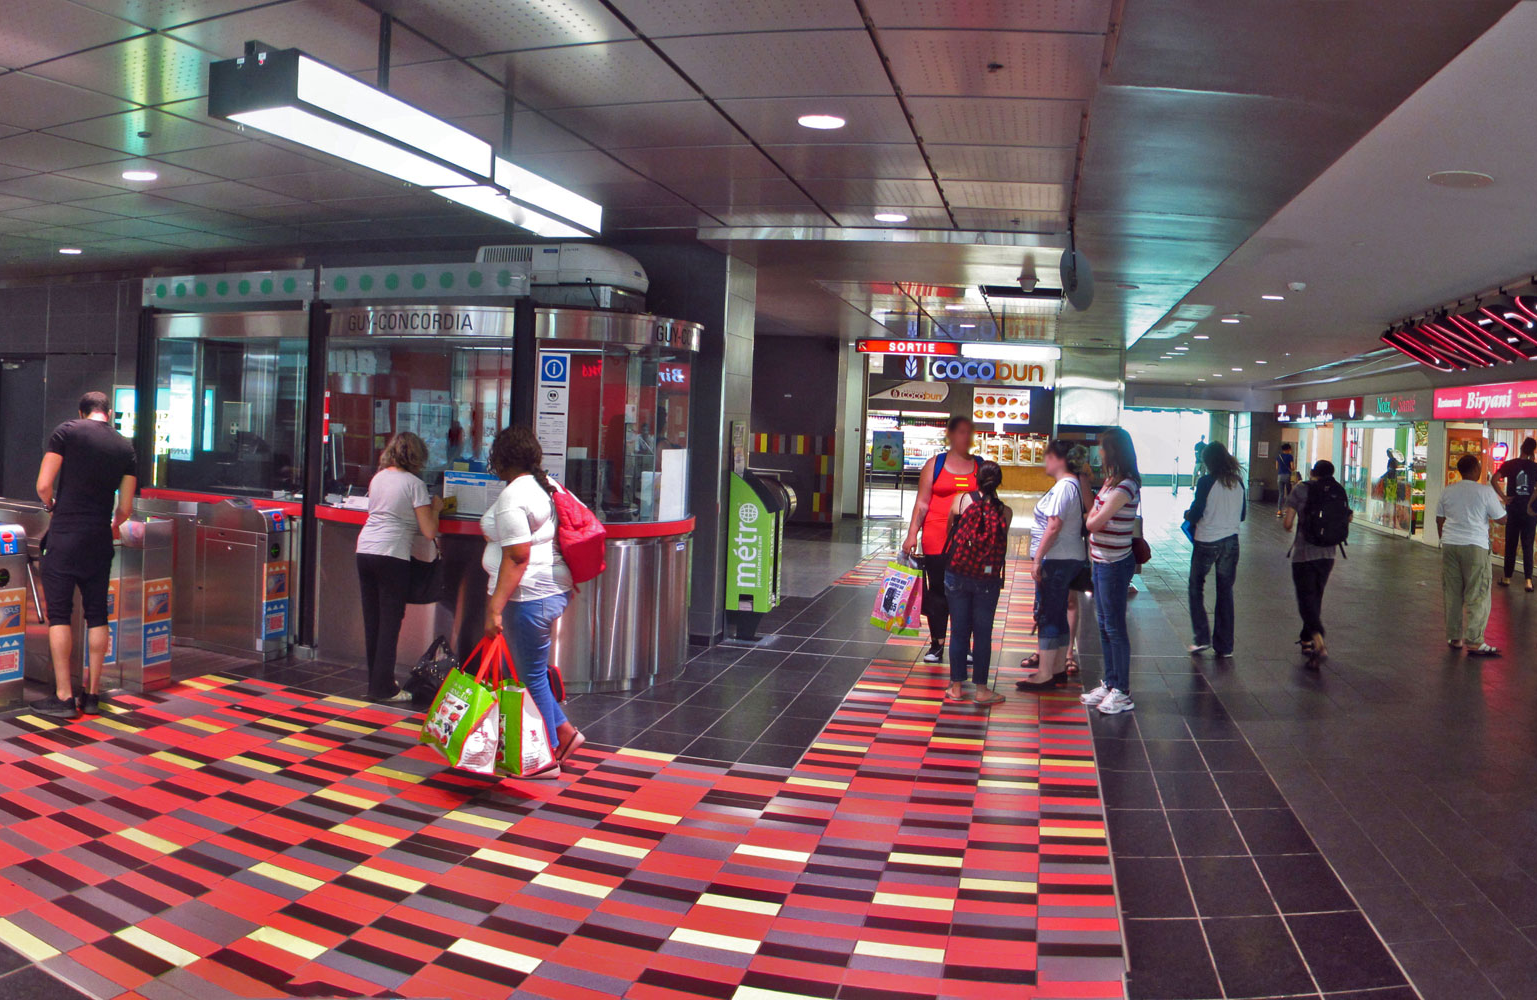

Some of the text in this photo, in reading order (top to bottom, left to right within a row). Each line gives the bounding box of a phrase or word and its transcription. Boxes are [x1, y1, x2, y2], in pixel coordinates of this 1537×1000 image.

[348, 312, 473, 331] GUY-CONCORDIA
[889, 342, 935, 352] SORTIE
[931, 360, 1043, 382] cocobun
[901, 391, 942, 400] cocobun
[1465, 389, 1512, 415] Biryani
